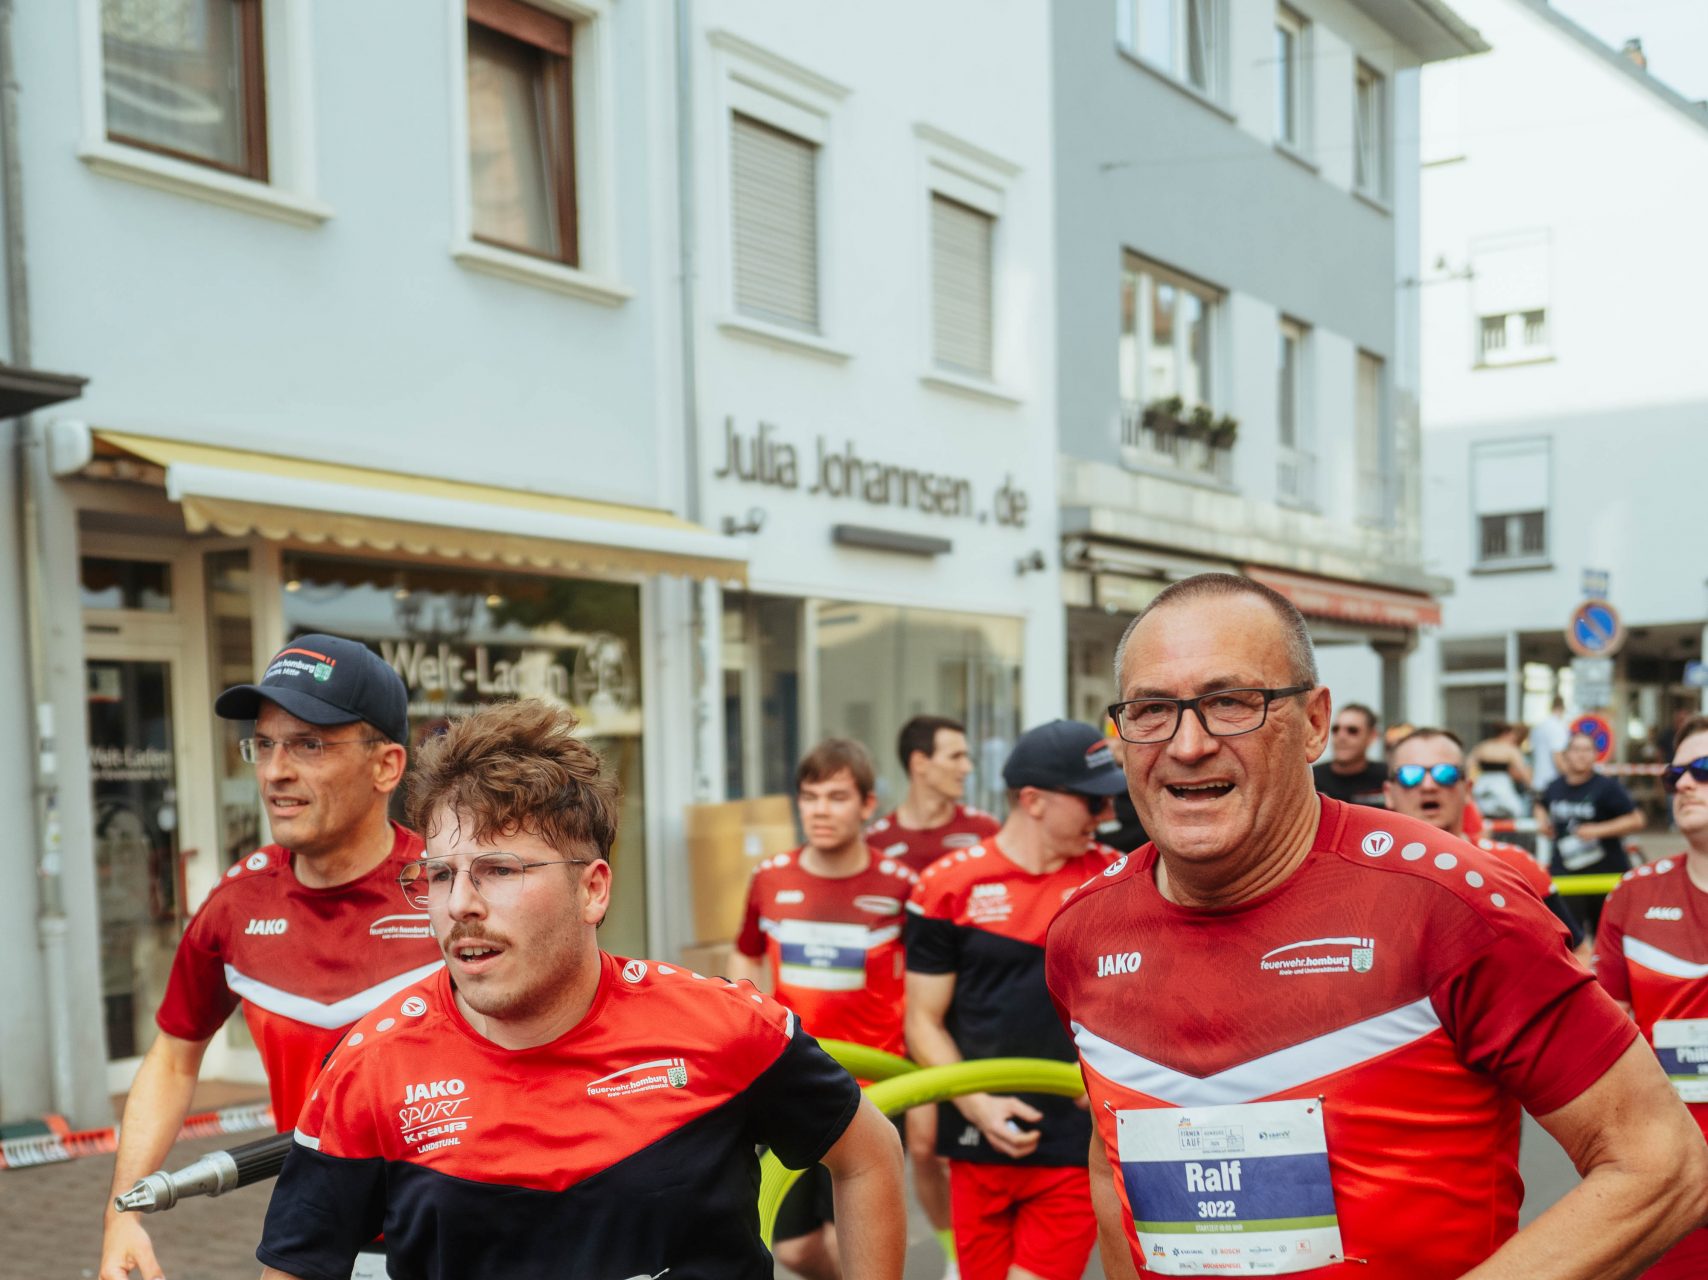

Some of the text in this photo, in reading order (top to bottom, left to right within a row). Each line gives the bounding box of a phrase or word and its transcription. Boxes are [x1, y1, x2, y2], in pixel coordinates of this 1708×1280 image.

[715, 415, 798, 490] Julia
[807, 434, 973, 518] Johannsen
[244, 918, 288, 935] JAKO
[1096, 951, 1142, 978] JAKO
[1260, 954, 1350, 971] feuerwehr.homburg
[404, 1079, 465, 1105] JAKO
[586, 1075, 668, 1096] feuerwehr.homburg
[399, 1097, 471, 1130] SPORT
[417, 1137, 461, 1154] LANDSTUHL
[1181, 1139, 1200, 1148] LAUF
[1184, 1160, 1242, 1193] Ralf
[1197, 1200, 1237, 1218] 3022
[1220, 1247, 1241, 1255] BOSCH
